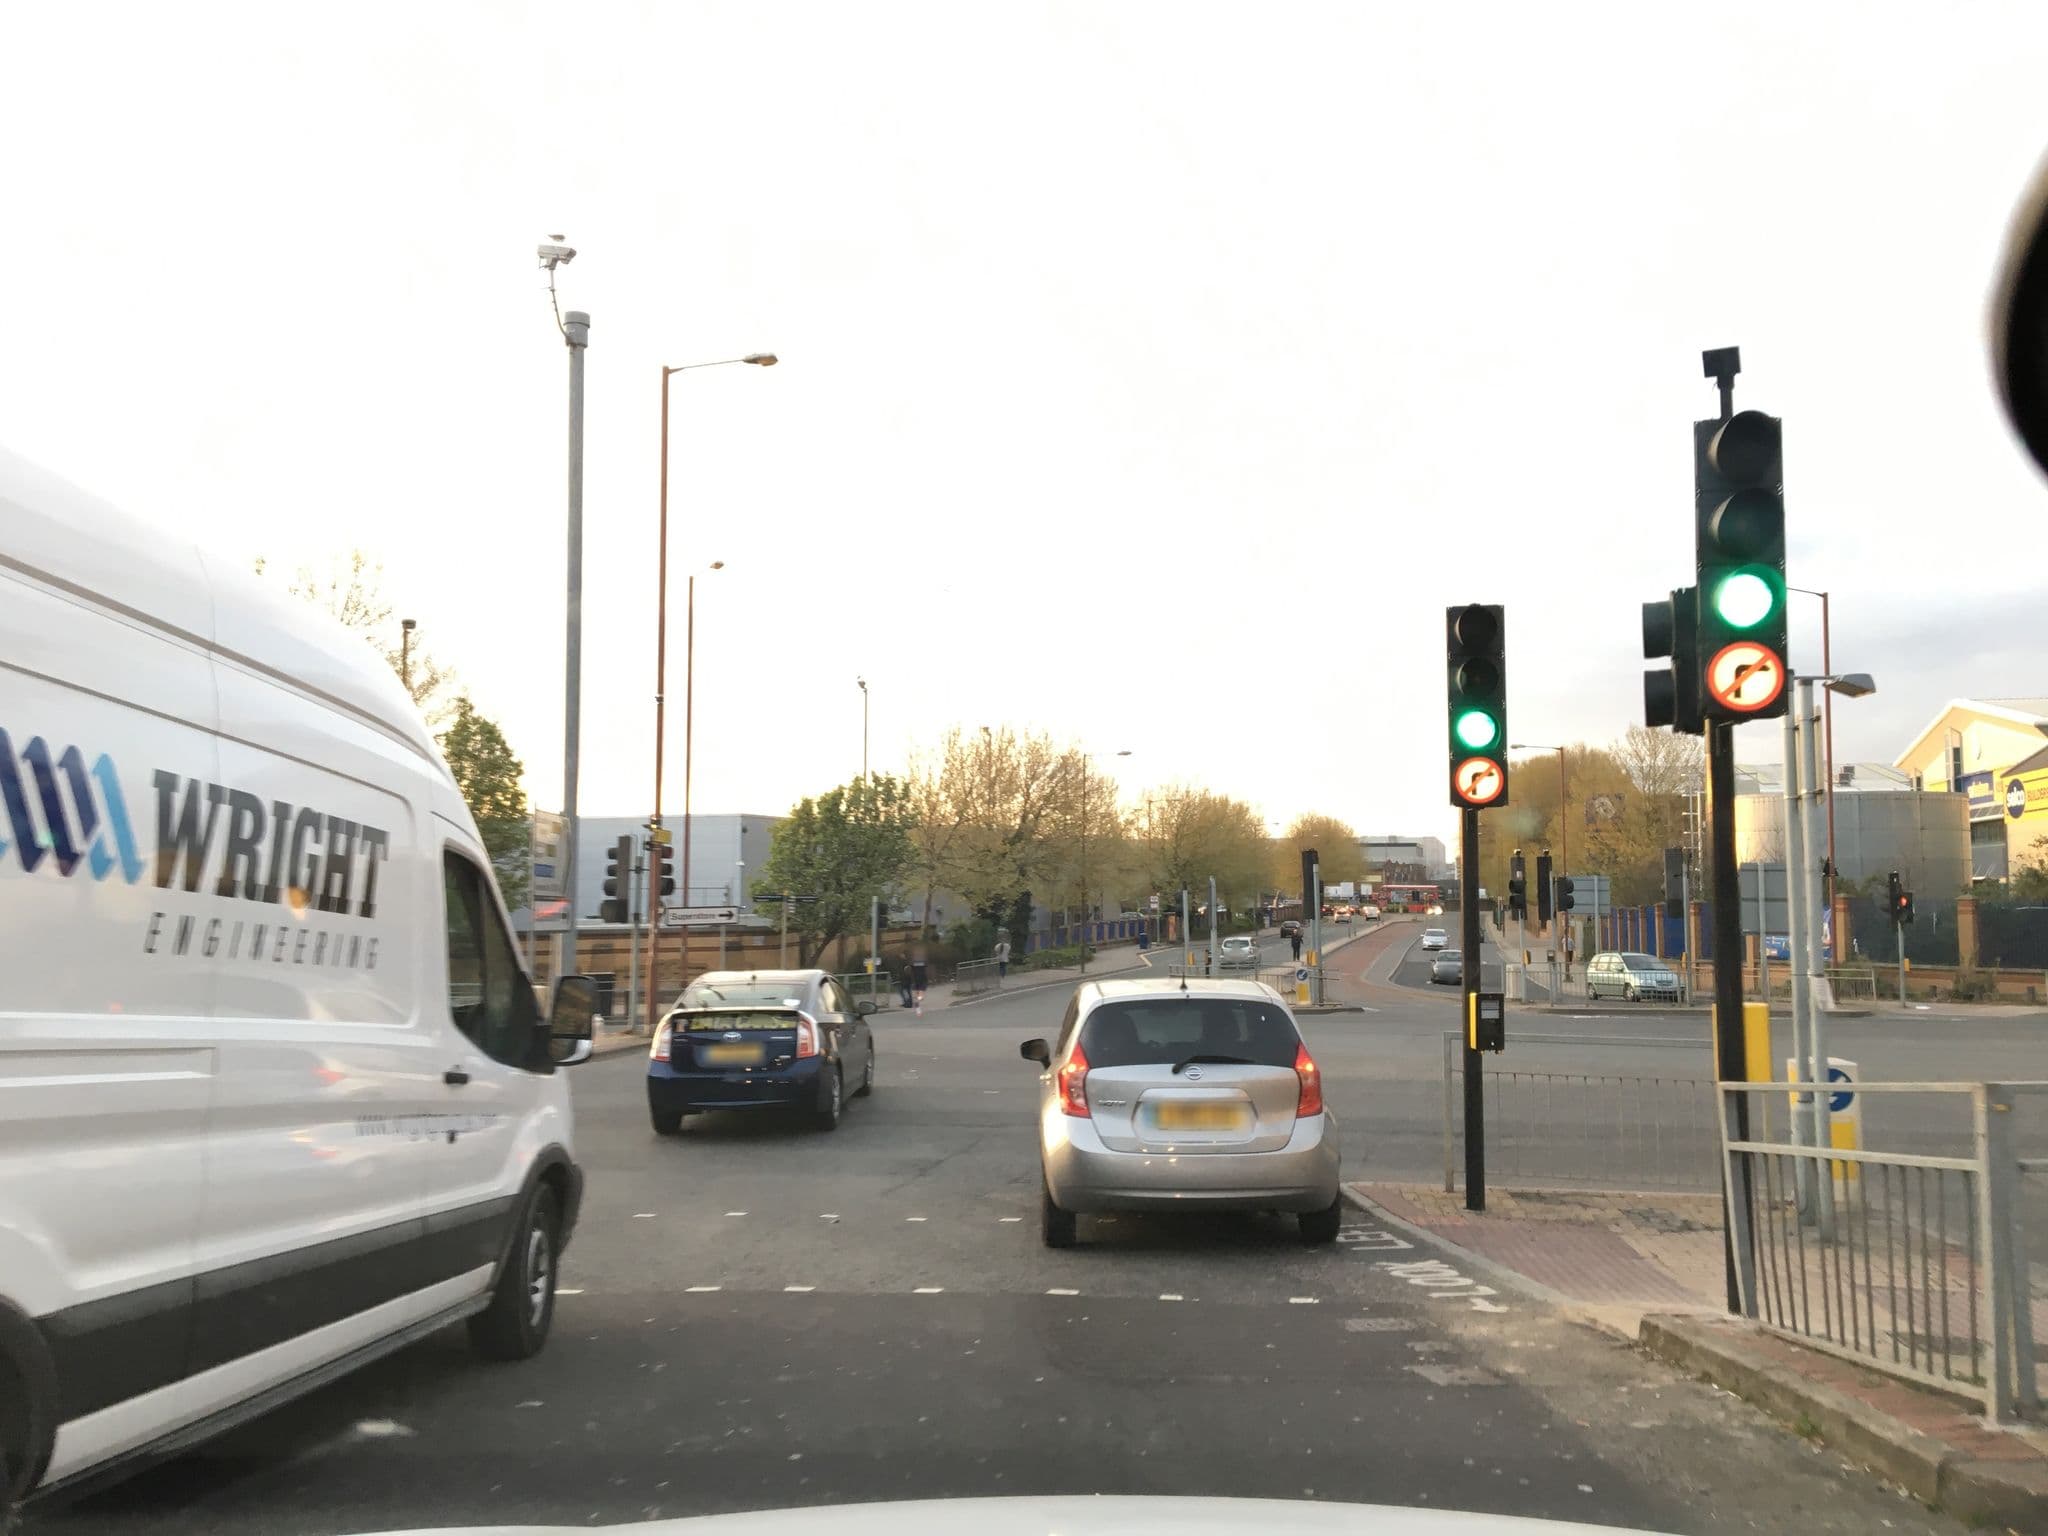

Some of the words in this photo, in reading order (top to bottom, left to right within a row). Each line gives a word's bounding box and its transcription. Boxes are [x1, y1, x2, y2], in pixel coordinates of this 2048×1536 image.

[2006, 787, 2025, 808] selco
[152, 768, 391, 919] WRIGHT
[144, 912, 380, 970] ENGINEERING
